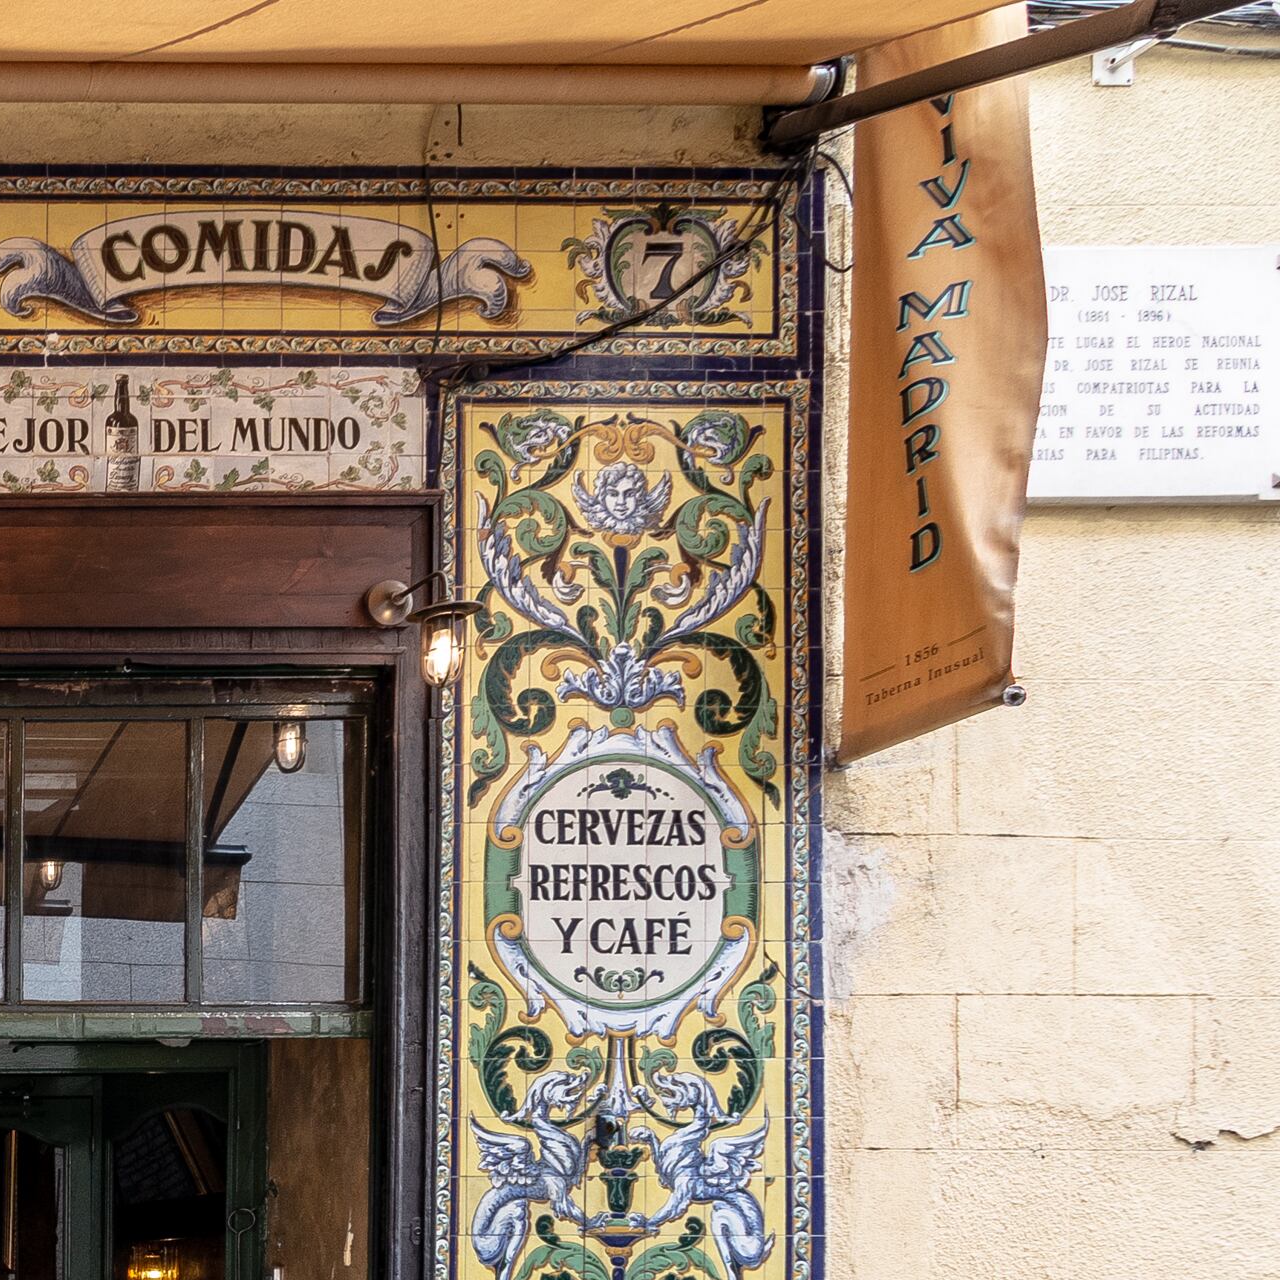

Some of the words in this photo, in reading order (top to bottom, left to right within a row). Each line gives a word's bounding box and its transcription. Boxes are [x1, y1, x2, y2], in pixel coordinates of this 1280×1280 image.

[100, 218, 414, 282] COMIDAS
[641, 241, 684, 300] 7
[1049, 286, 1074, 303] DR.
[1091, 285, 1129, 302] JOSE
[1150, 284, 1199, 302] RIZAL
[1138, 310, 1172, 323] 1896)
[1076, 336, 1115, 349] LUGAR
[1126, 336, 1142, 349] EL
[1152, 336, 1192, 349] HEROE
[1201, 335, 1262, 348] NACIONAL
[1053, 359, 1074, 372] DR.
[1084, 359, 1114, 371] JOSE
[1130, 358, 1168, 371] RIZAL
[1184, 358, 1200, 371] SE
[1216, 358, 1261, 370] REUNIA
[1077, 382, 1170, 394] COMPATRIOTAS
[1190, 381, 1222, 394] PARA
[1243, 381, 1260, 393] LA
[1099, 404, 1115, 416] DE
[1147, 404, 1162, 416] SU
[1194, 403, 1261, 416] ACTIVIDAD
[151, 418, 222, 453] DEL
[230, 415, 361, 453] MUNDO
[896, 279, 974, 574] MADRID
[1059, 426, 1075, 439] EN
[1085, 426, 1122, 438] FAVOR
[1134, 426, 1150, 438] DE
[1161, 426, 1184, 438] LAS
[1196, 425, 1260, 438] REFORMAS
[1086, 448, 1117, 461] PARA
[1138, 448, 1205, 461] FILIPINAS.
[904, 643, 940, 667] 1856
[865, 677, 922, 706] Taberna
[928, 647, 985, 681] Inusual
[534, 808, 707, 847] CERVEZAS
[528, 863, 718, 902] REFRESCOS
[551, 917, 584, 954] Y
[590, 911, 693, 955] CAFÉ
